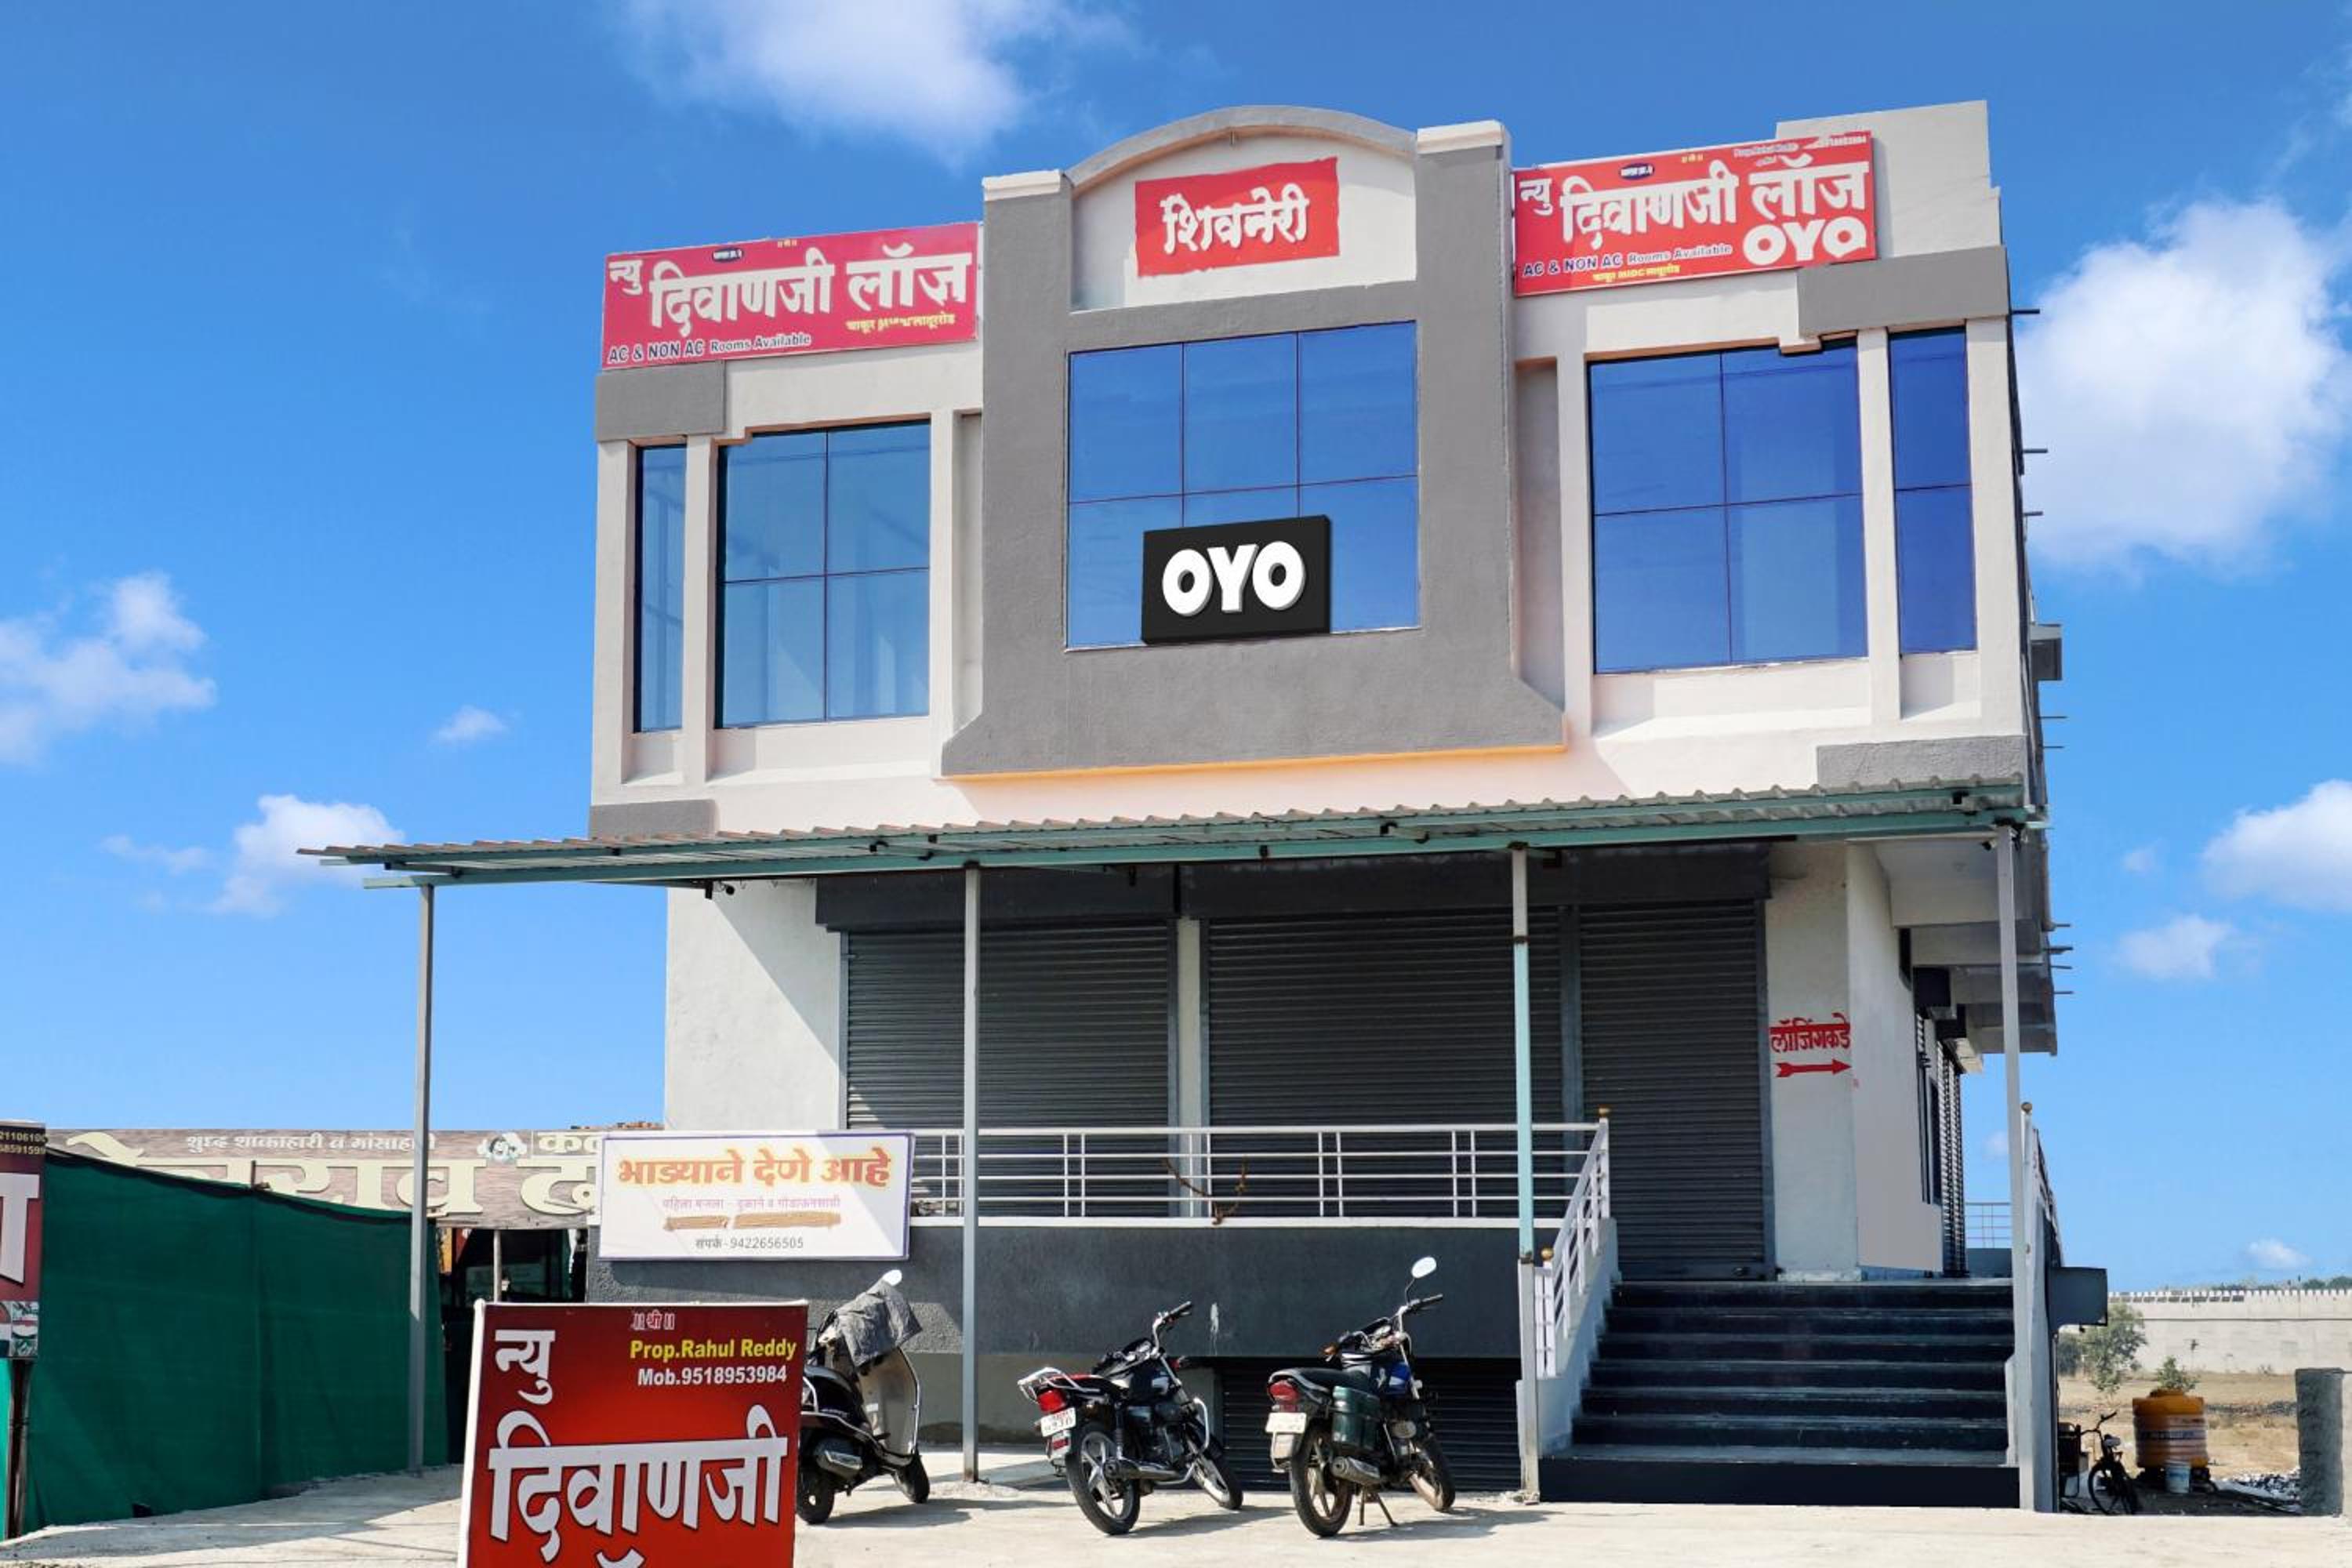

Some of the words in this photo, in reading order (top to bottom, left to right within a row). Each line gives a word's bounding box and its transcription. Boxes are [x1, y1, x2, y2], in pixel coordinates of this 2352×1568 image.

[1159, 183, 1310, 255] शिवनेरी
[1559, 158, 1739, 250] दिवाणजी
[1748, 154, 1870, 220] लॉज
[1523, 263, 1543, 277] AC
[1564, 258, 1597, 272] NON
[1602, 253, 1622, 267] AC
[1628, 249, 1671, 264] Rooms
[1673, 244, 1733, 260] Available
[1742, 215, 1867, 265] OYO
[648, 246, 836, 338] दिवाणजी
[845, 241, 972, 312] लॉज
[609, 347, 628, 363] AC
[648, 342, 680, 358] NON
[684, 339, 704, 356] AC
[710, 339, 751, 352] Rooms
[753, 333, 811, 350] Available
[1162, 540, 1306, 617] OYO
[753, 1148, 812, 1187] देणे
[821, 1146, 892, 1188] आहे
[495, 1328, 556, 1406] न्यु
[630, 1339, 735, 1363] Prop.Rahul
[740, 1338, 797, 1361] Reddy
[637, 1366, 788, 1387] Mob.9518953984
[488, 1403, 789, 1563] दिवाणजी
